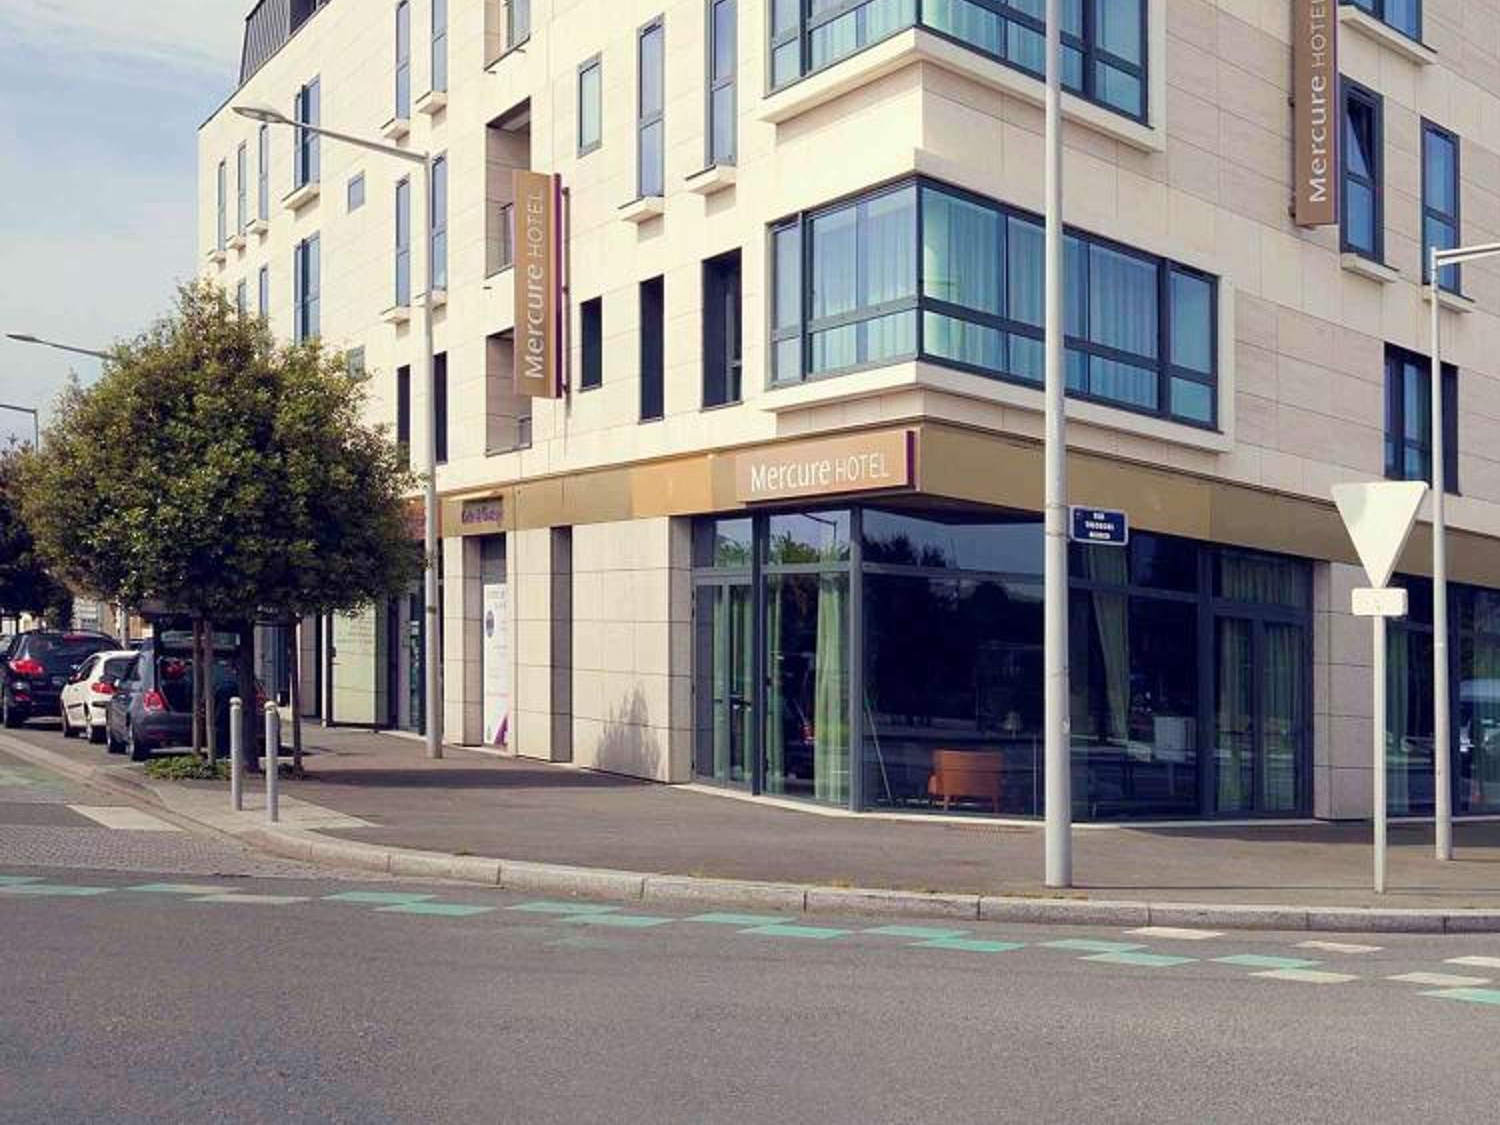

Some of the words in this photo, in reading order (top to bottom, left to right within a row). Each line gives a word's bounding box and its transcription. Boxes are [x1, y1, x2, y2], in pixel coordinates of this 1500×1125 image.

[1309, 76, 1326, 202] Mercure
[527, 189, 544, 259] HOTEL
[525, 265, 545, 379] Mercure
[750, 460, 832, 492] Mercure
[835, 452, 889, 484] HOTEL
